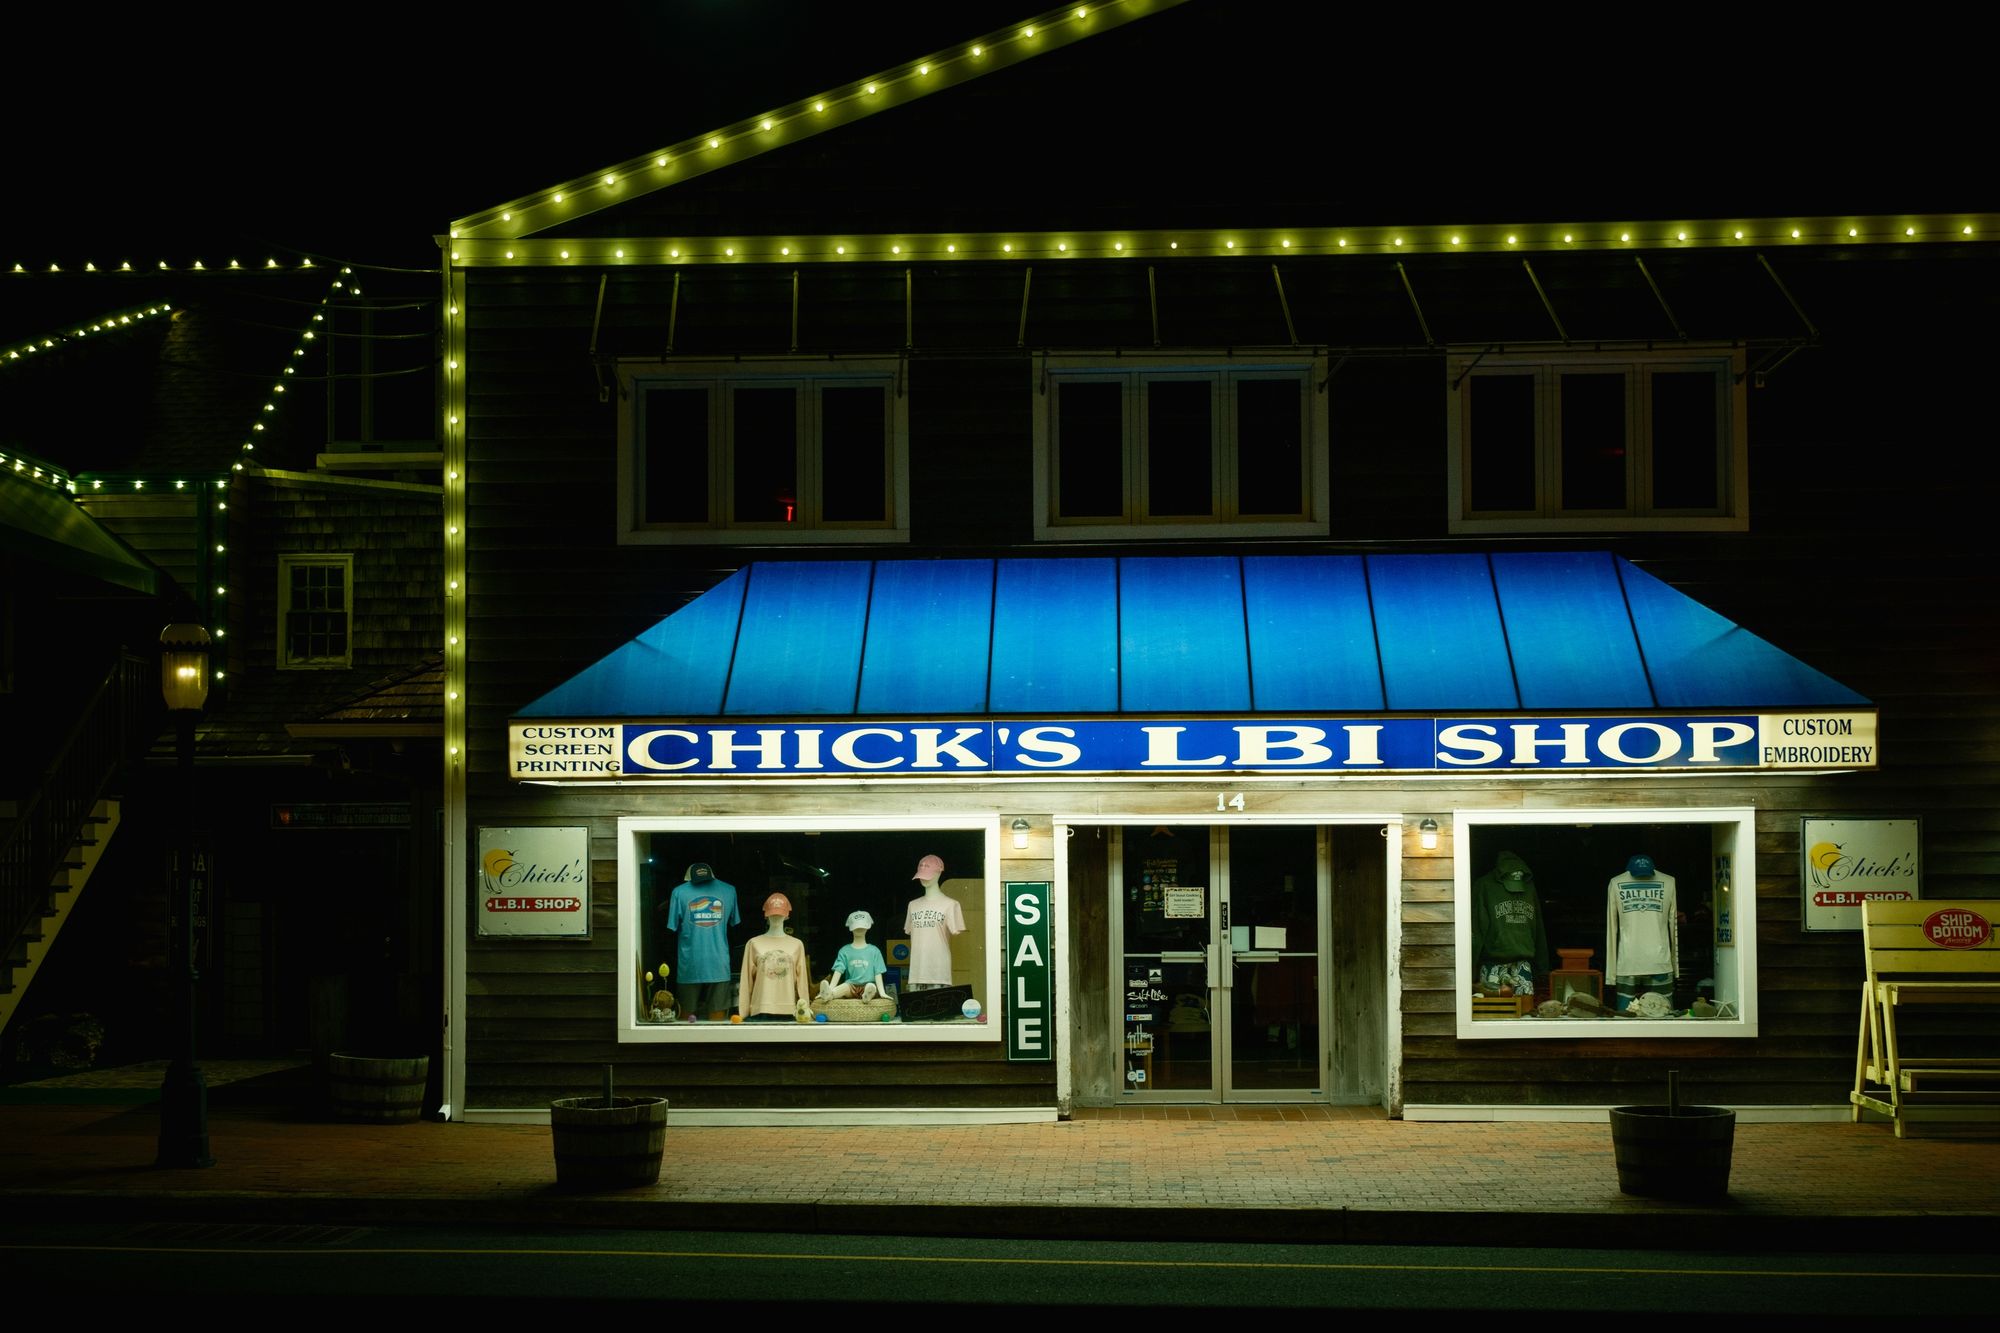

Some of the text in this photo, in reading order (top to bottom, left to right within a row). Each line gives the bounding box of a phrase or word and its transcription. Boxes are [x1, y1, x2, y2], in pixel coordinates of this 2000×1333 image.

[522, 727, 615, 739] CUSTOM
[1783, 719, 1852, 735] CUSTOM
[525, 744, 612, 755] SCREEN
[628, 722, 1755, 770] CHICK'S LBI SHOP
[1764, 746, 1872, 763] EMBROIDERY
[516, 760, 621, 772] PRINTING
[1216, 792, 1245, 811] 14
[494, 859, 584, 887] Chick's
[1824, 853, 1914, 881] Chick's
[1620, 890, 1664, 900] SALT LIFE
[1822, 893, 1859, 903] L.B.I.
[494, 899, 574, 909] L.B.I. SHOP
[1940, 914, 1973, 926] SHIP
[1933, 926, 1983, 938] BOTTOM
[1014, 893, 1044, 1050] SALE
